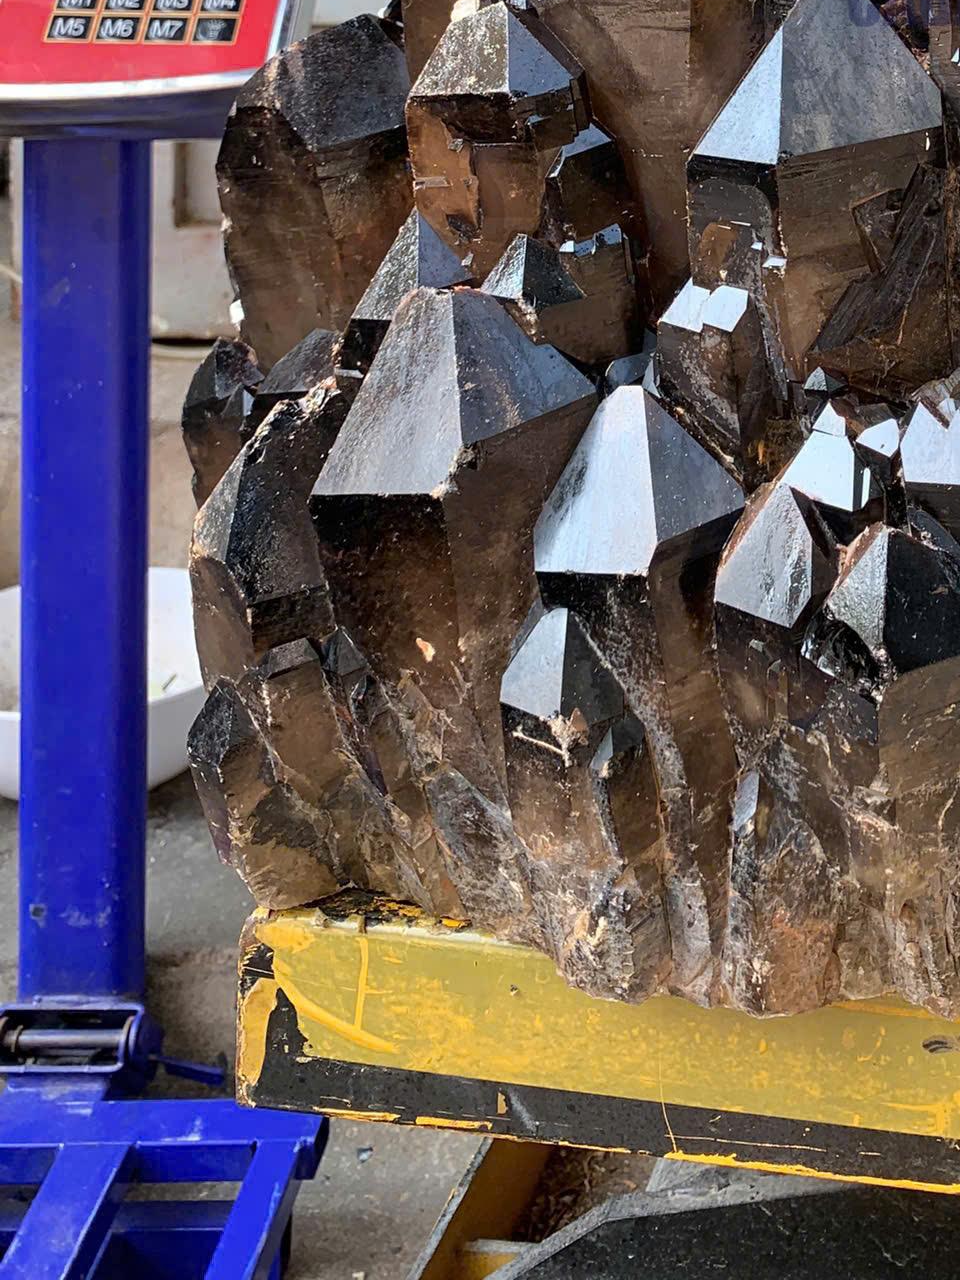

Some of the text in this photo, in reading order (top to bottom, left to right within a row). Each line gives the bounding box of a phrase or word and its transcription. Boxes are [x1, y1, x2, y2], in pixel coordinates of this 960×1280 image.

[55, 17, 183, 37] M5 M6 M7
